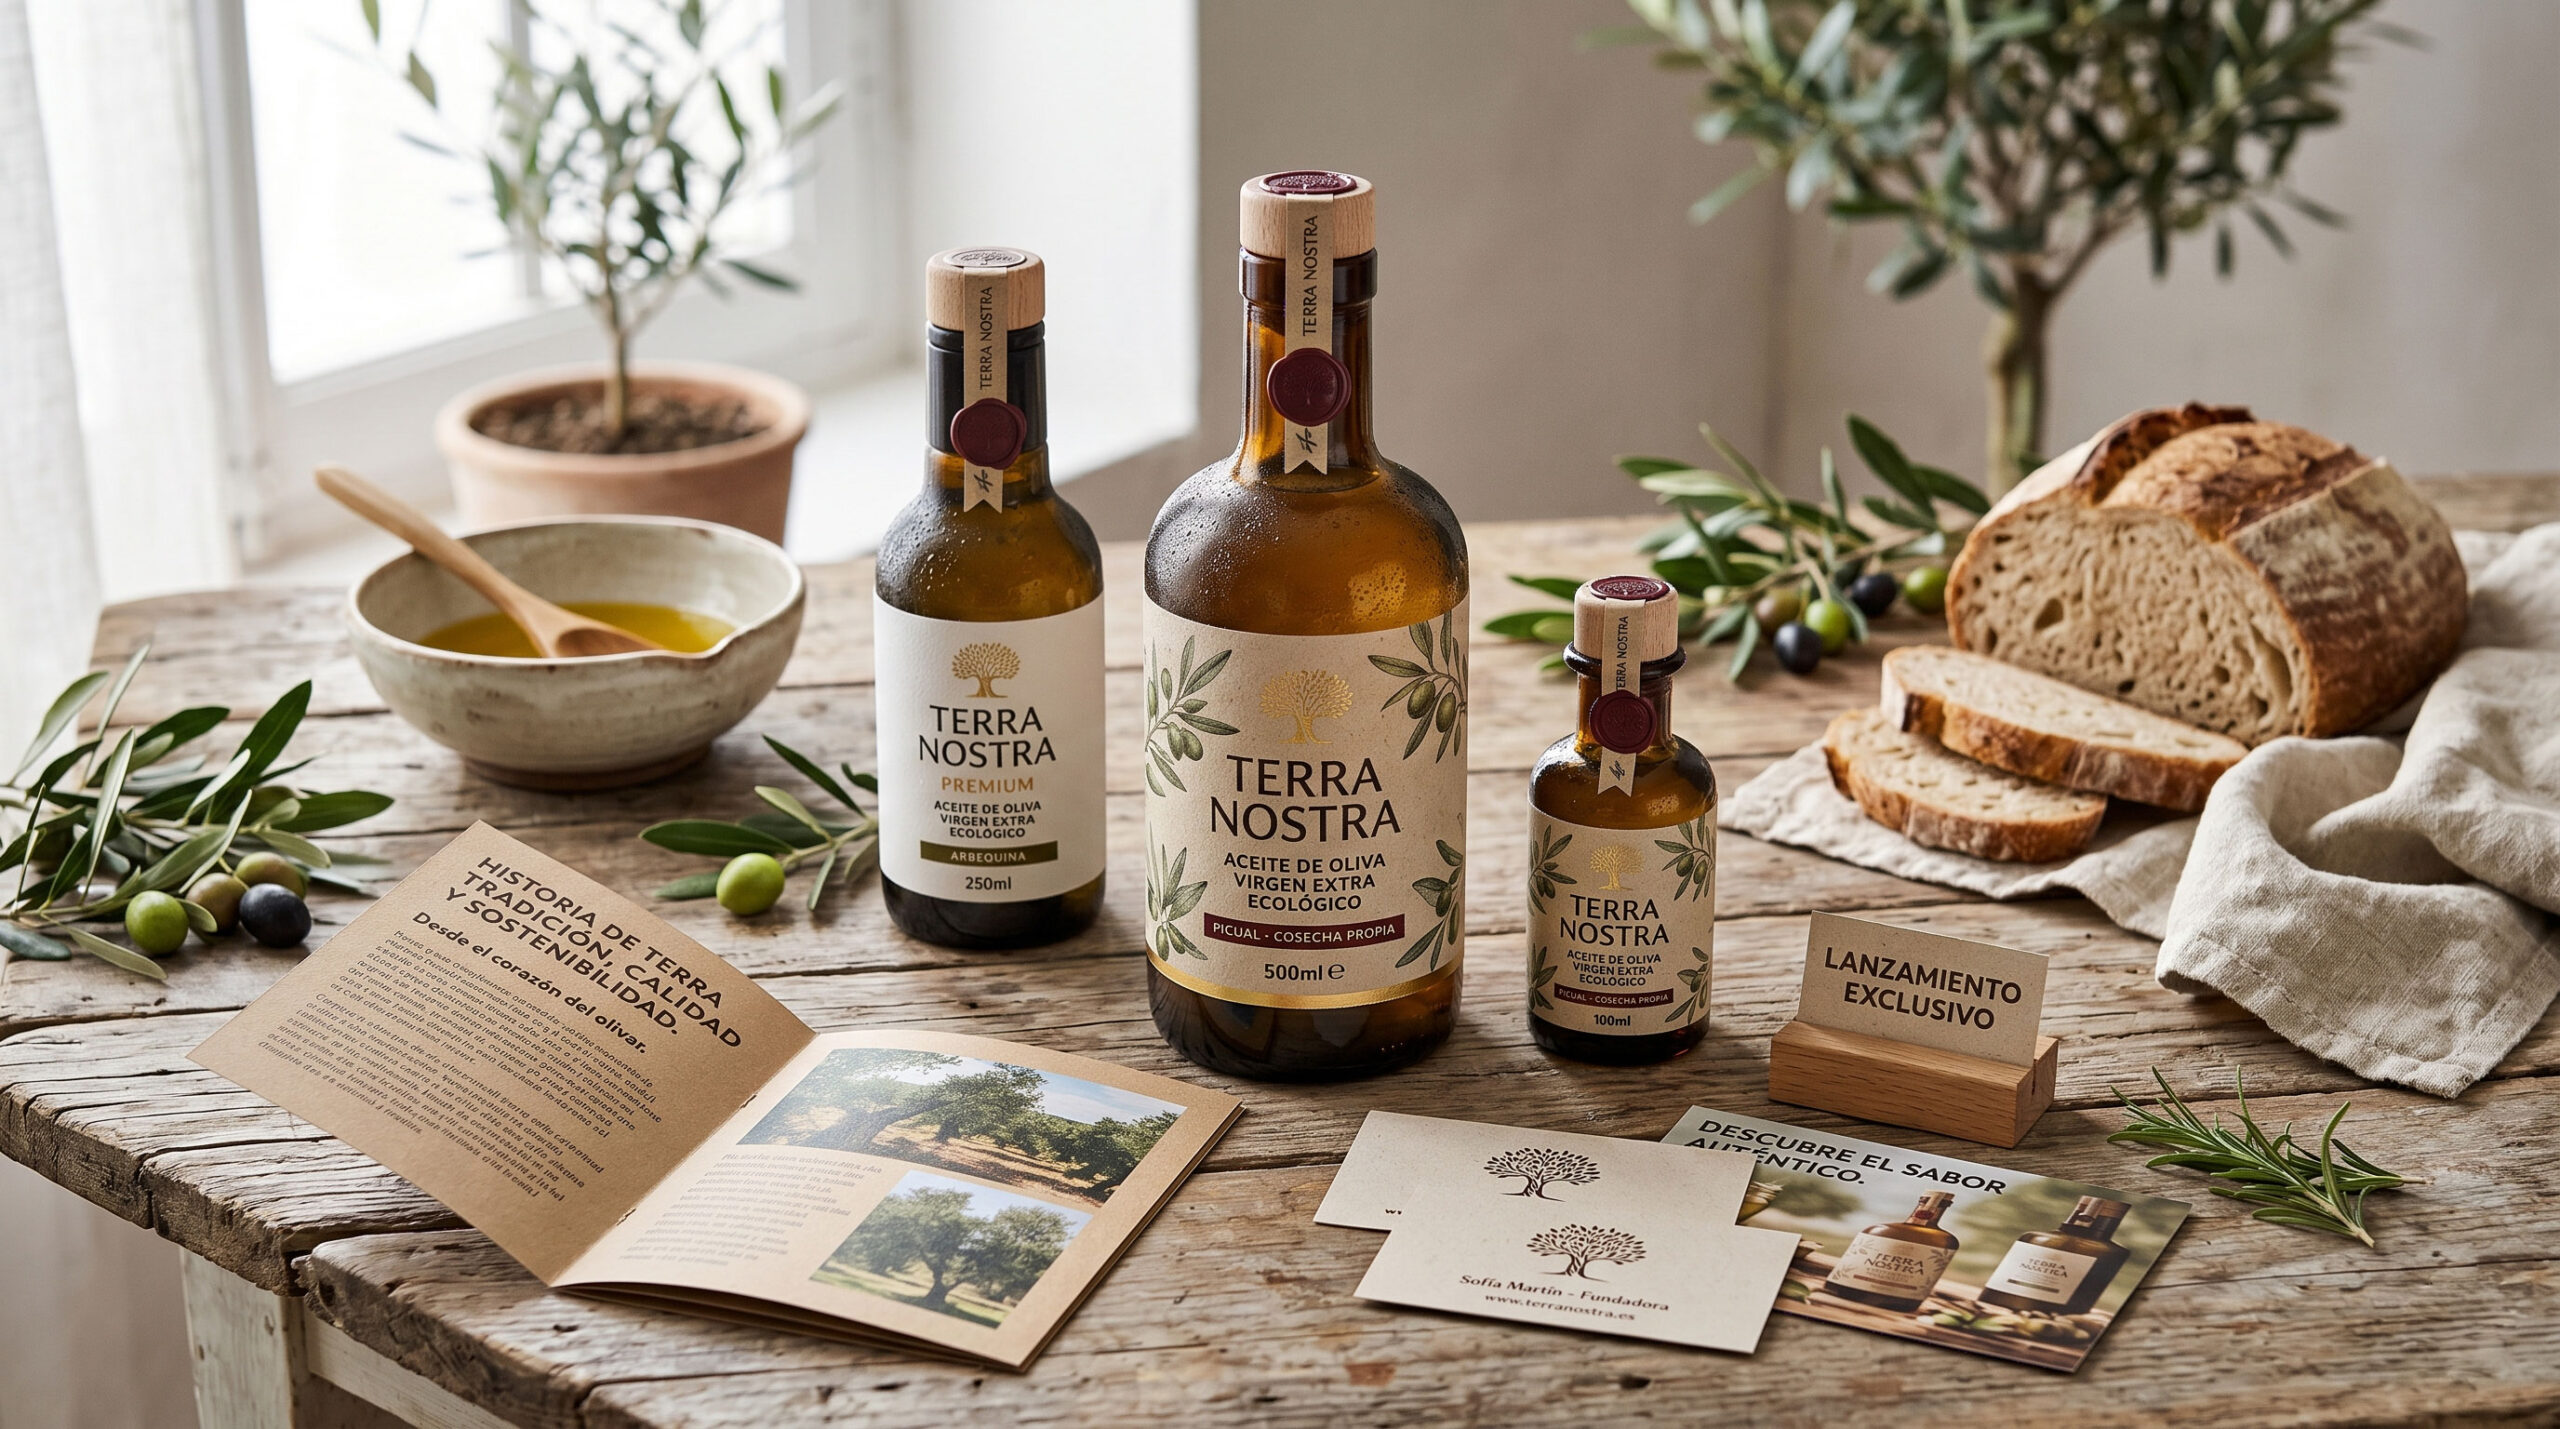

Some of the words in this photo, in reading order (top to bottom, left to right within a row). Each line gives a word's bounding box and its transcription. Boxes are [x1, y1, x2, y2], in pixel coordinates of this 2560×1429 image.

[1303, 215, 1318, 281] NOSTRA
[980, 286, 993, 341] NOSTRA
[1303, 285, 1317, 336] TERRA
[979, 346, 993, 390] TERRA
[1617, 616, 1628, 659] NOSTRA
[929, 704, 1043, 736] TERRA
[919, 735, 1056, 769] NOSTRA
[941, 776, 1034, 794] PREMIUM
[1226, 754, 1384, 798] TERRA
[934, 800, 978, 814] ACEITE
[982, 804, 1000, 815] DE
[1003, 801, 1042, 814] OLIVA
[940, 814, 988, 827] VIRGEN
[992, 814, 1036, 827] EXTRA
[1210, 796, 1401, 843] NOSTRA
[950, 827, 1026, 839] ECOLÓGICO
[950, 851, 1026, 863] ARBEQUINA
[1223, 852, 1290, 873] ACEITE
[1296, 858, 1323, 874] DE
[1329, 853, 1386, 873] OLIVA
[965, 876, 1012, 890] 250ml
[1233, 872, 1306, 893] VIRGEN
[1314, 873, 1376, 893] EXTRA
[1248, 891, 1362, 912] ECOLÓGICO
[1570, 894, 1660, 921] TERRA
[477, 856, 597, 929] HISTORIA
[600, 923, 642, 953] DE
[647, 946, 724, 1010] TERRA
[1212, 922, 1261, 941] PICUAL
[1273, 930, 1343, 943] COSECHA
[1347, 924, 1396, 940] PROPIA
[1560, 917, 1670, 947] NOSTRA
[445, 887, 467, 903] Y
[463, 899, 678, 1036] SOSTENIBILIDAD.
[463, 871, 614, 968] TRADICIÓN,
[624, 963, 743, 1048] CALIDAD
[1264, 963, 1323, 981] 500ml
[1567, 950, 1605, 963] ACEITE
[1609, 955, 1623, 964] DE
[1627, 954, 1661, 964] OLIVA
[1573, 961, 1615, 975] VIRGEN
[1618, 966, 1654, 975] EXTRA
[412, 911, 470, 947] Desde
[472, 942, 493, 958] el
[492, 955, 562, 1000] corazón
[564, 994, 596, 1016] del
[594, 1013, 647, 1054] olivar.
[1824, 947, 2022, 1004] LANZAMIENTO
[1559, 988, 1587, 1001] PICUAL
[1595, 996, 1636, 1005] COSECHA
[1639, 994, 1669, 1004] PROPIA
[1844, 981, 1995, 1030] EXCLUSIVO
[1594, 1014, 1631, 1026] 100ml
[1698, 1119, 1857, 1163] DESCUBRE
[1862, 1153, 1894, 1173] EL
[1900, 1162, 2008, 1196] SABOR
[1459, 1274, 1503, 1289] Sofía
[1506, 1280, 1563, 1297] Martín
[1580, 1290, 1670, 1311] Fundadora
[1485, 1293, 1636, 1321] www.terranostra.es
